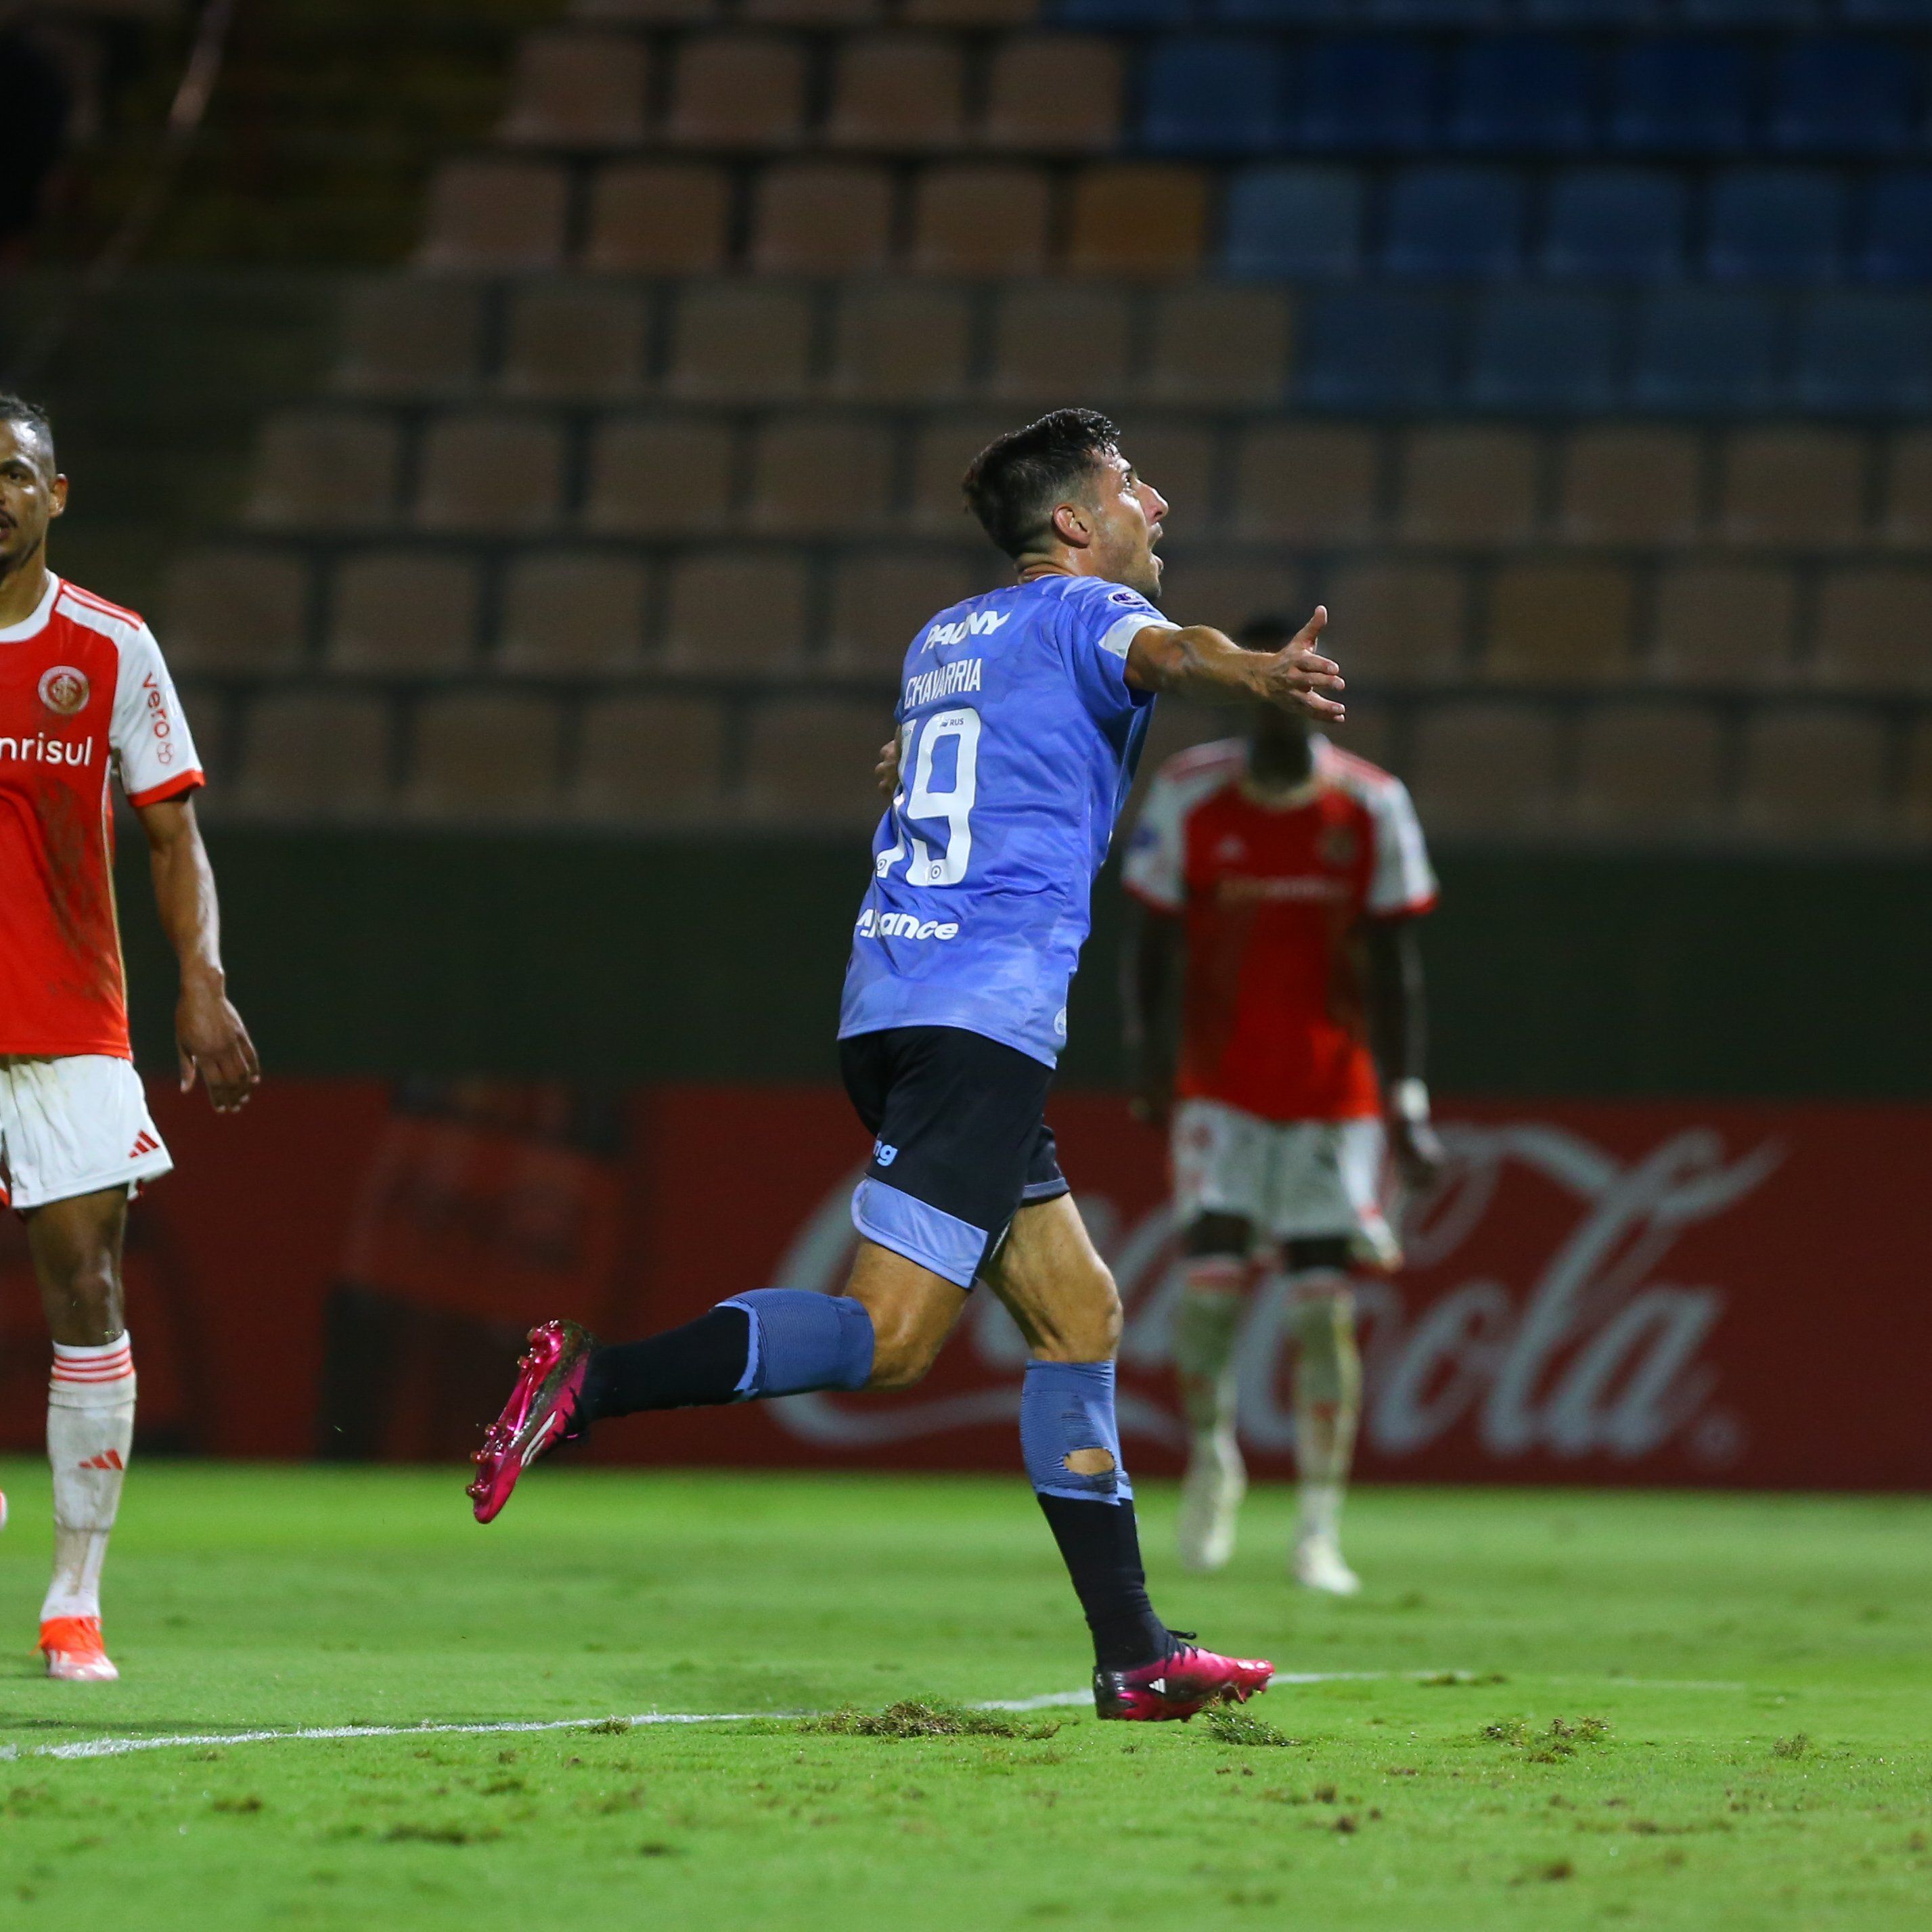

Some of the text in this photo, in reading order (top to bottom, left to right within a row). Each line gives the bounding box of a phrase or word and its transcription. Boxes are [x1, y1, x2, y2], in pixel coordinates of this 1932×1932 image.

[920, 610, 1012, 654] PAUNY
[142, 671, 170, 738] vero
[904, 658, 981, 709] CHAVARRIA
[949, 718, 964, 726] RUS
